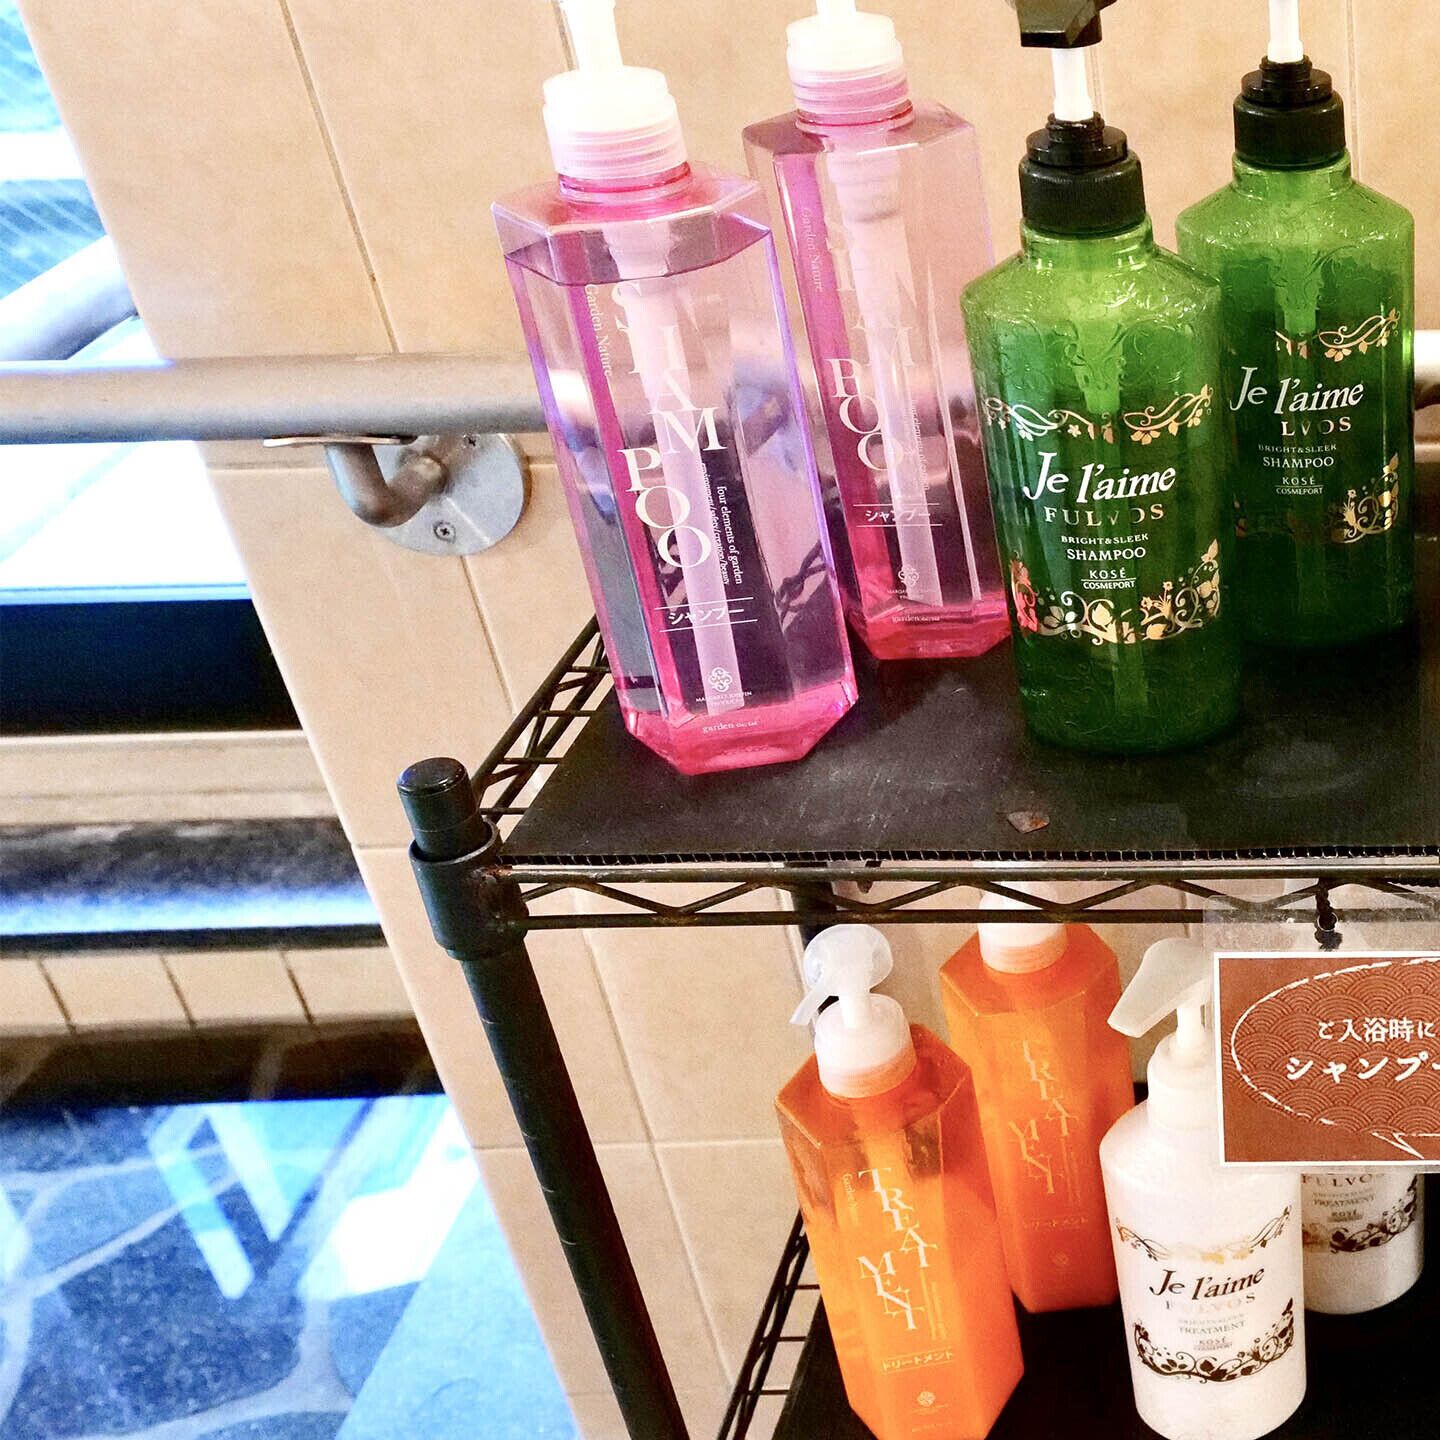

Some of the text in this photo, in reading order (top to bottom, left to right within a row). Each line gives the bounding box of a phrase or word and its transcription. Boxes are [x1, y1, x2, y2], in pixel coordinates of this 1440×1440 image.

[1229, 366, 1364, 414] Je l'aime
[1262, 456, 1334, 468] SHAMPOO
[1022, 451, 1176, 503] Je l'aime
[716, 486, 743, 585] four elements of garden
[1061, 533, 1150, 545] BRIGHT&SLEEK
[1067, 547, 1146, 561] SHAMPOO
[1089, 567, 1126, 579] KOSÉ
[1083, 580, 1135, 590] COSMEPORT
[702, 721, 734, 734] garden
[1301, 1173, 1384, 1187] FULVO
[1149, 1268, 1265, 1300] Je l'aime
